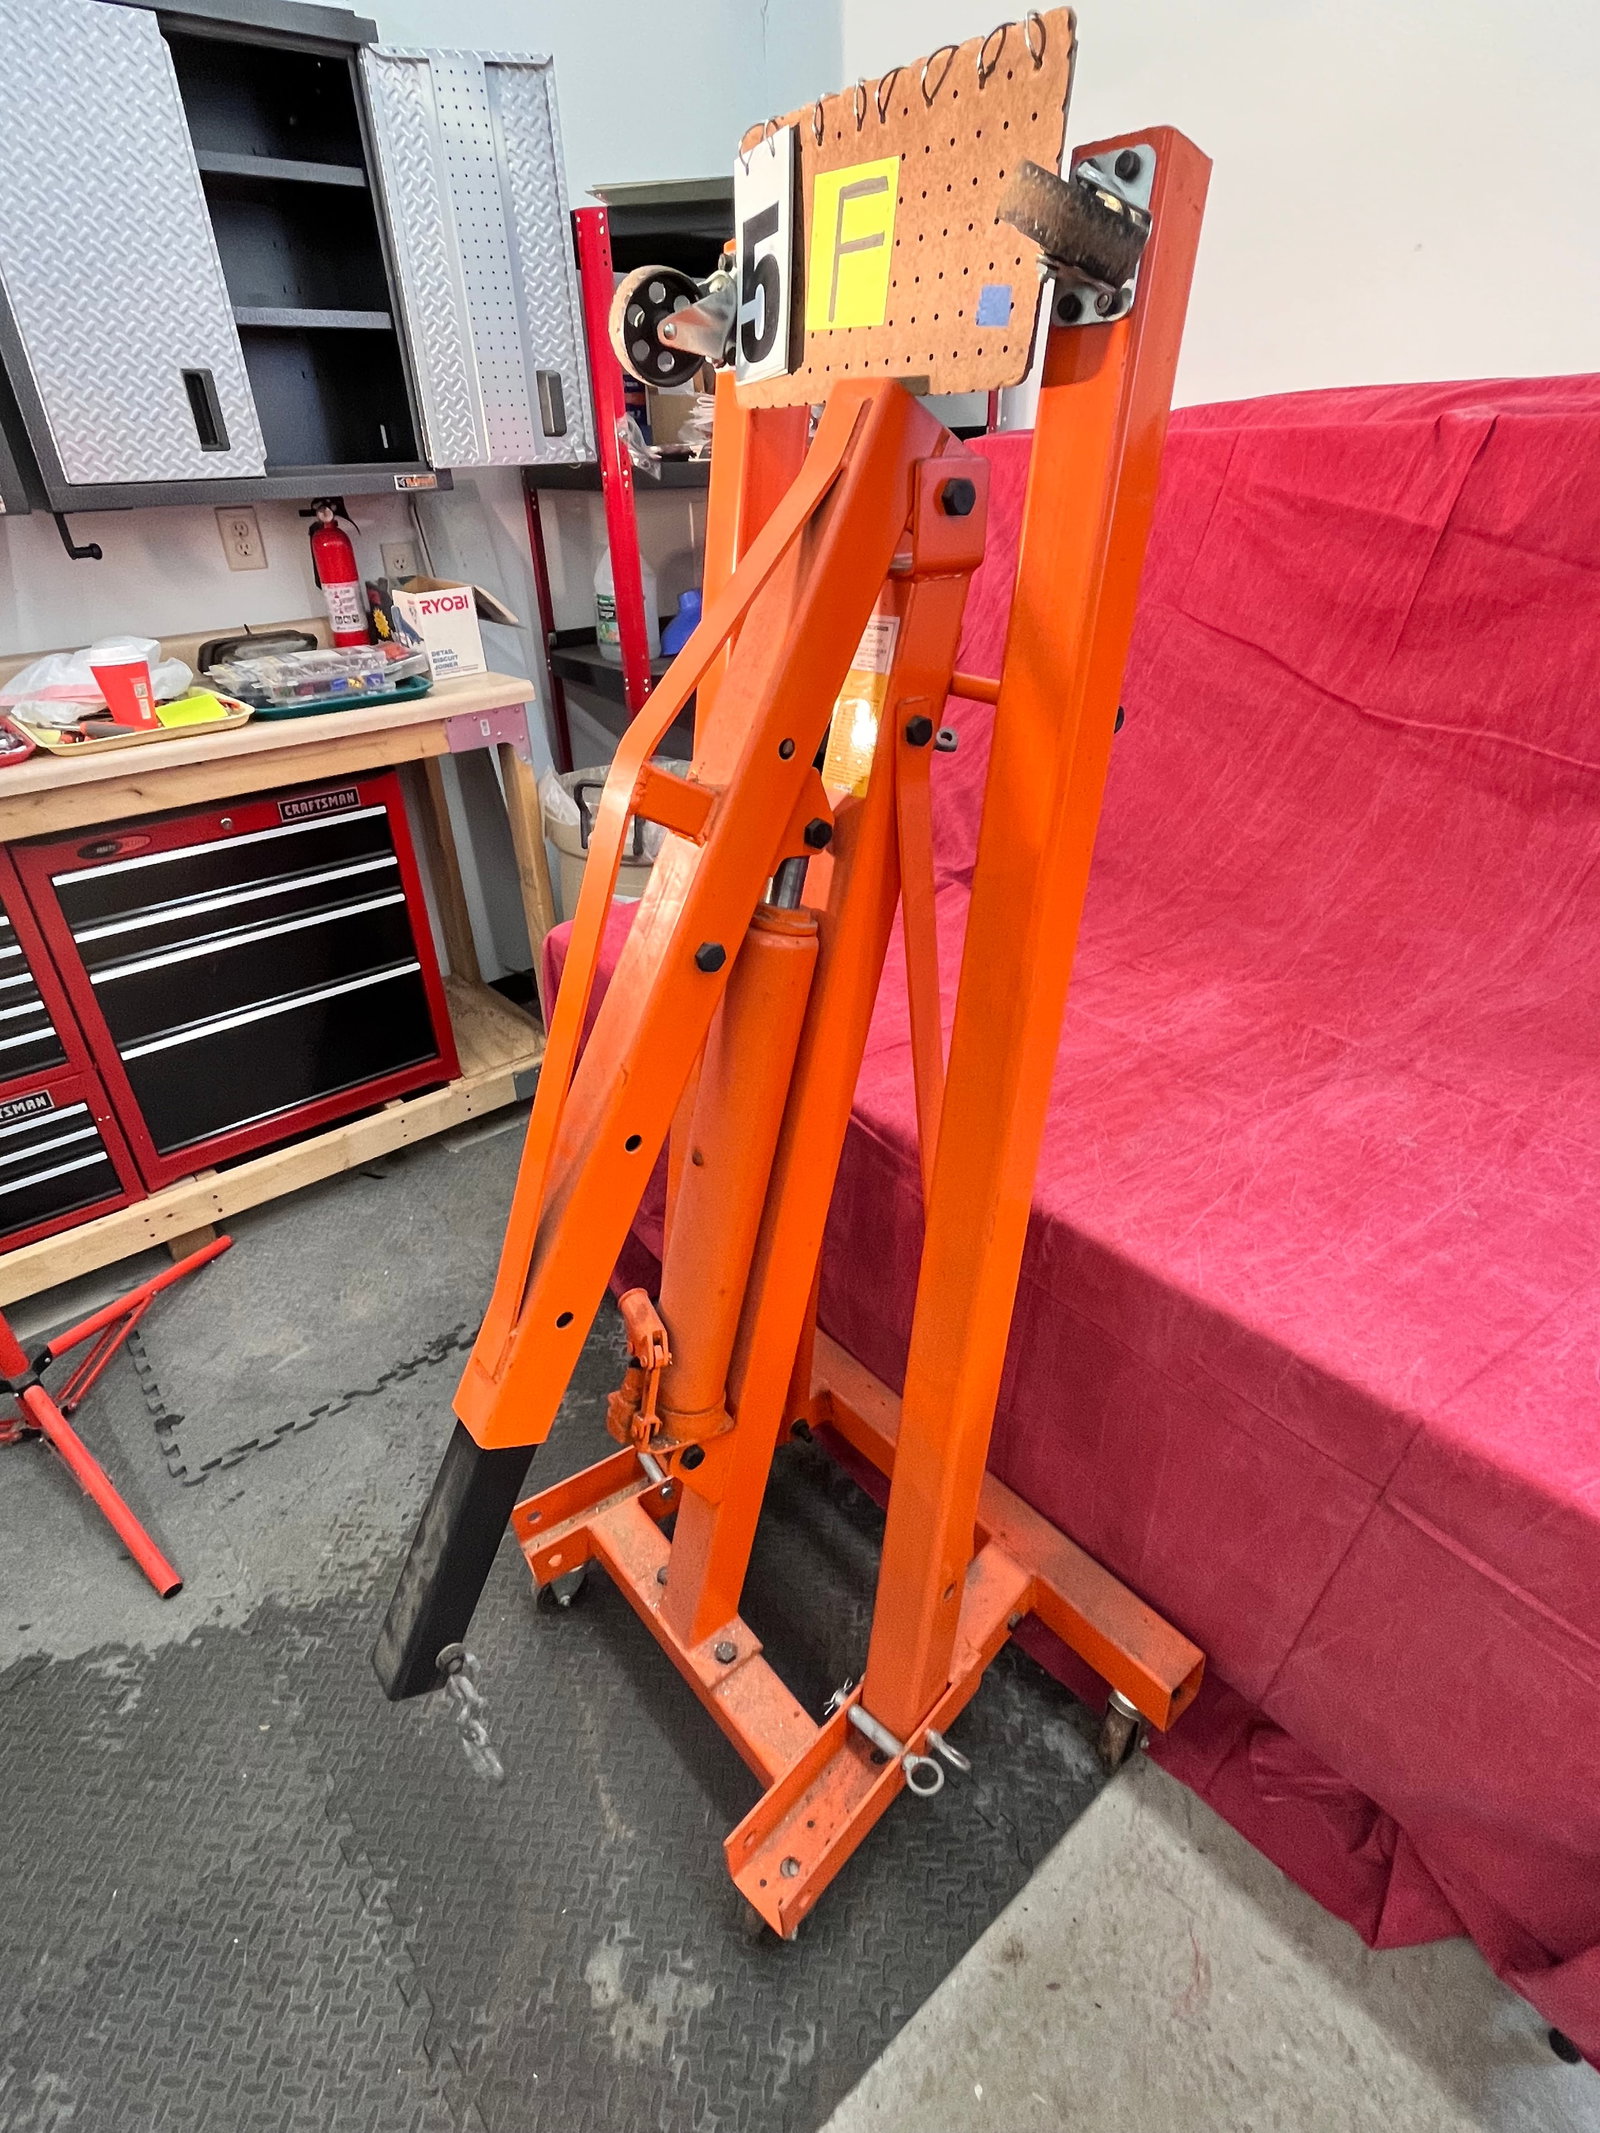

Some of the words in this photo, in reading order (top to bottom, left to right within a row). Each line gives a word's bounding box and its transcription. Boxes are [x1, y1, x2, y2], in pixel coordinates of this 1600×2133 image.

[741, 200, 780, 363] 5
[828, 176, 889, 322] F
[419, 594, 469, 615] RYOBI
[284, 792, 355, 816] CRAFTSMAN
